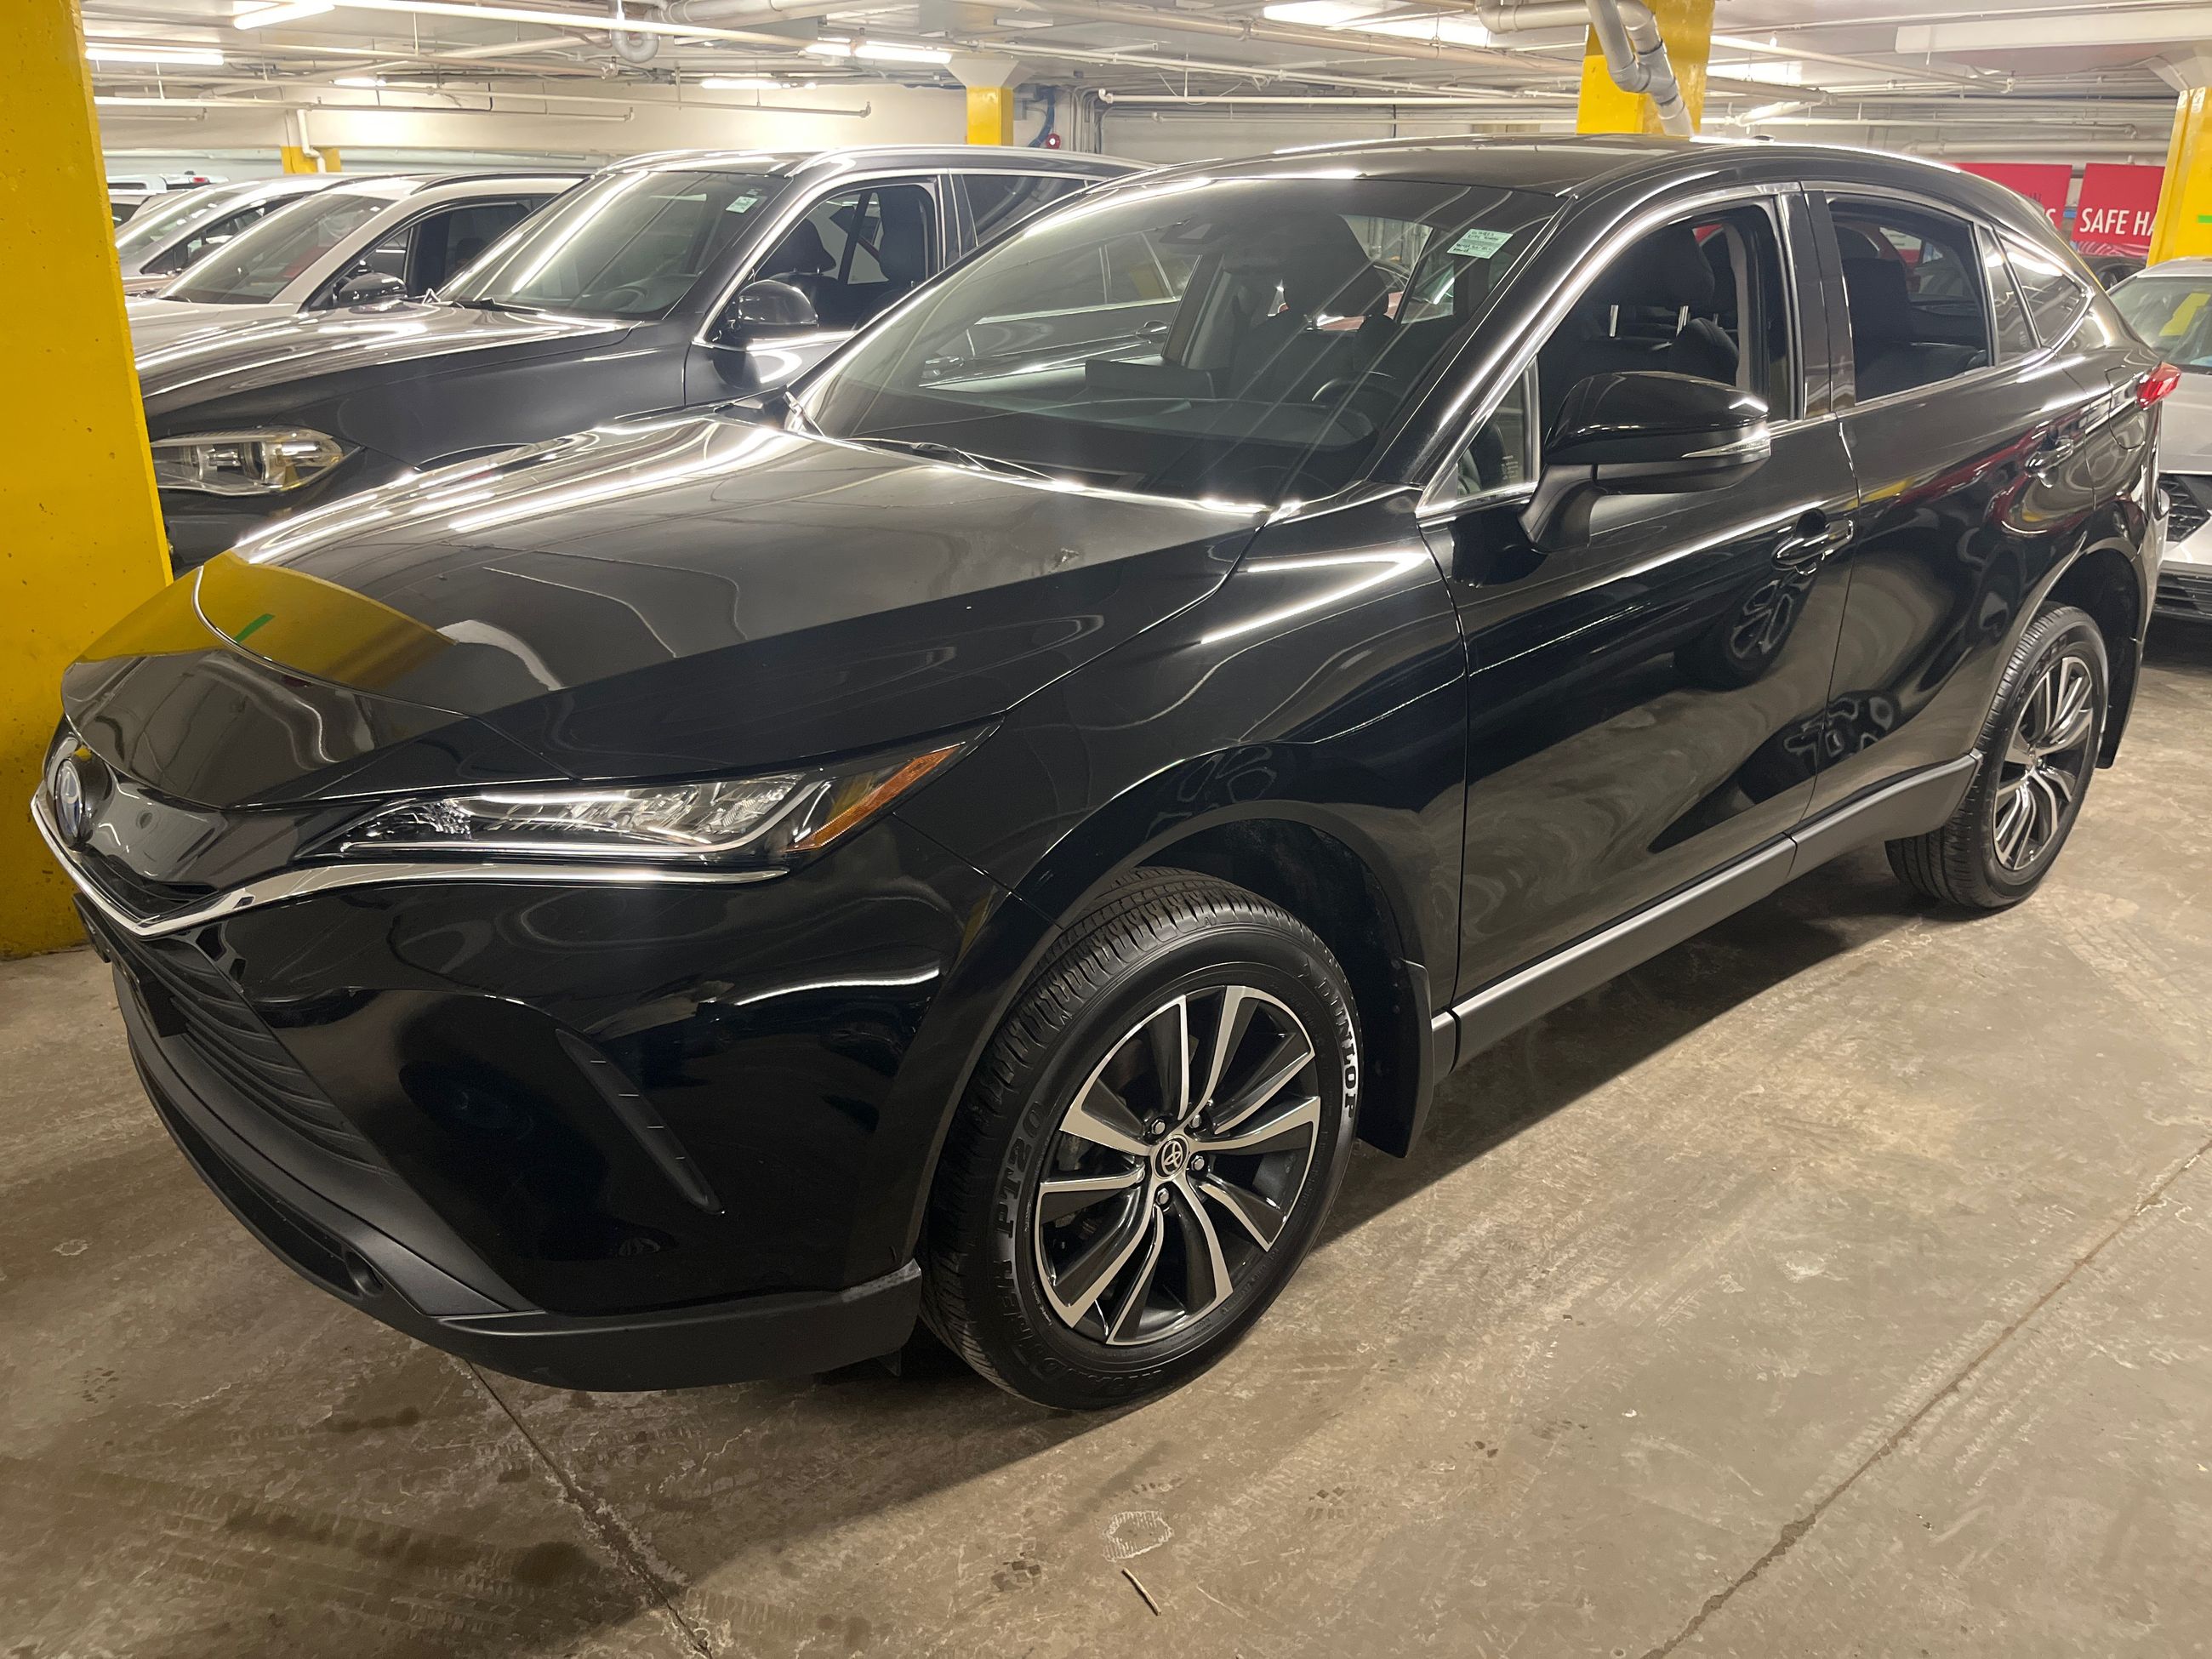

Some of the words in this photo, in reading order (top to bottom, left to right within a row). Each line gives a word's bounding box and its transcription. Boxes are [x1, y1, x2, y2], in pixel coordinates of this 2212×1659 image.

[2079, 208, 2129, 235] SAFE
[1314, 977, 1357, 1118] DUNLOP
[996, 1100, 1044, 1239] PT20
